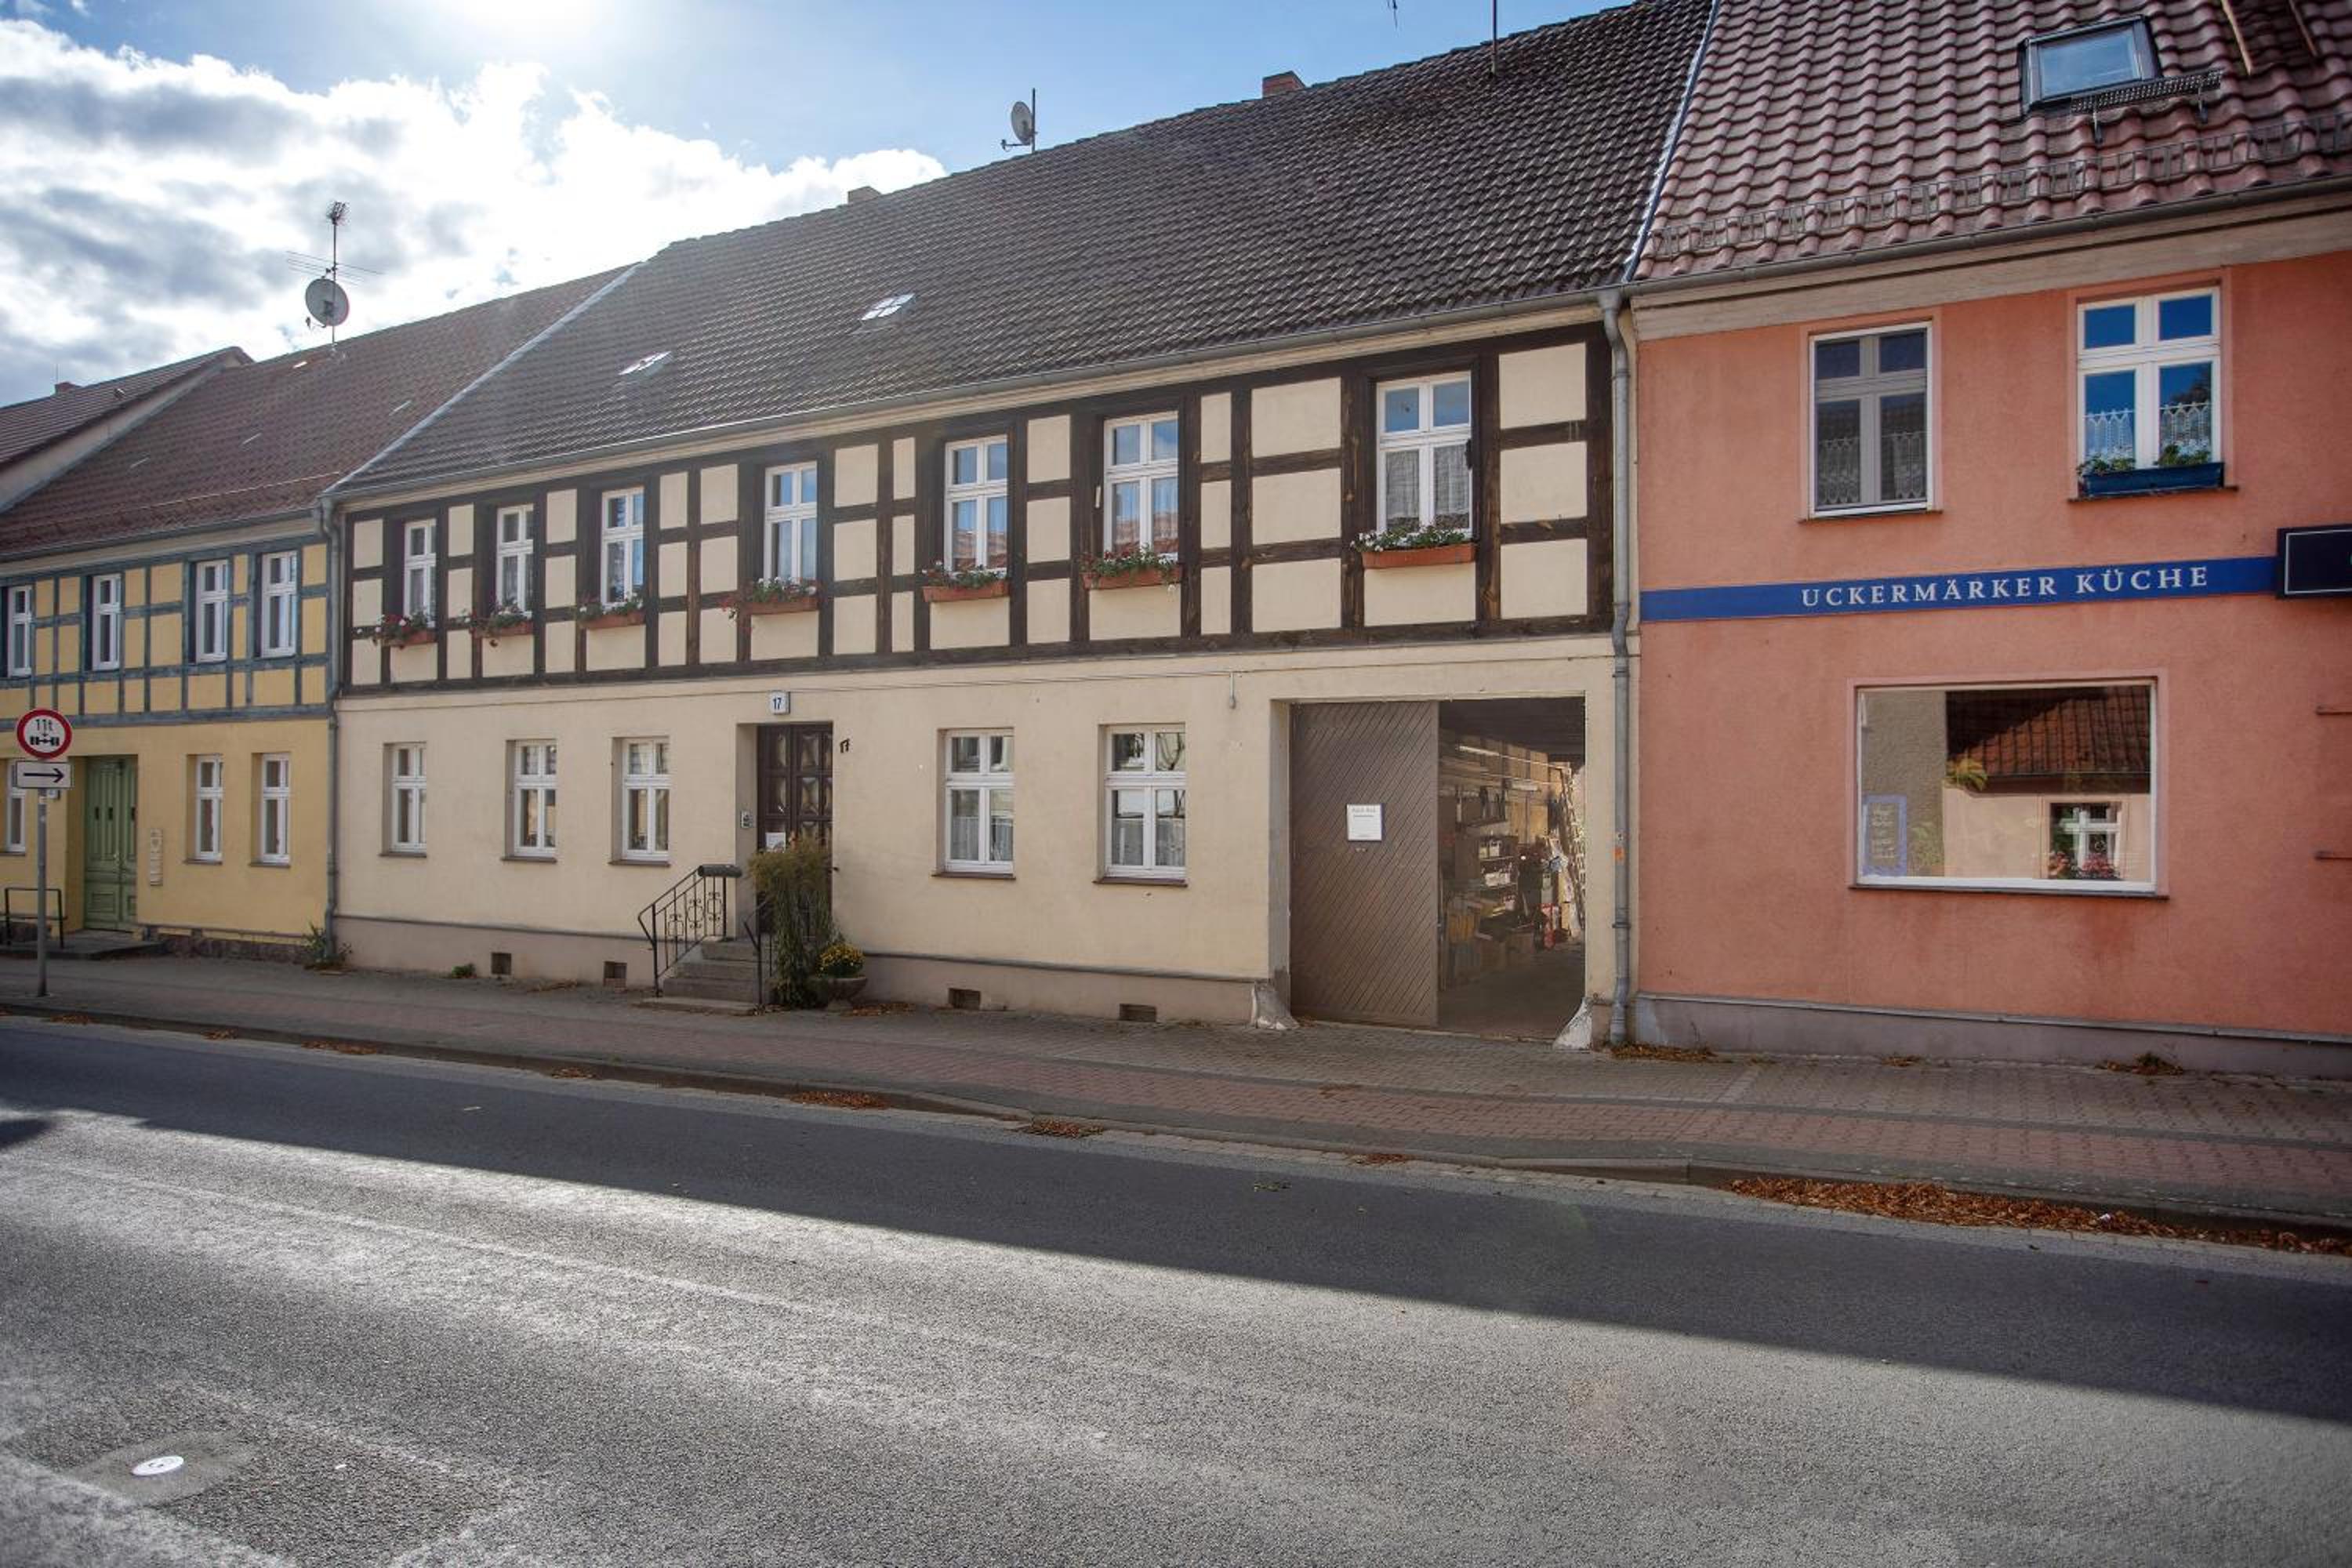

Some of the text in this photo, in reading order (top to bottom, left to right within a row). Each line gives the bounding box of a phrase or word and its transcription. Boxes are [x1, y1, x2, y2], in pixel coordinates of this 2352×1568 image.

[1802, 566, 2208, 607] UCKERMÄRKER KÜCHE
[772, 697, 782, 710] 17
